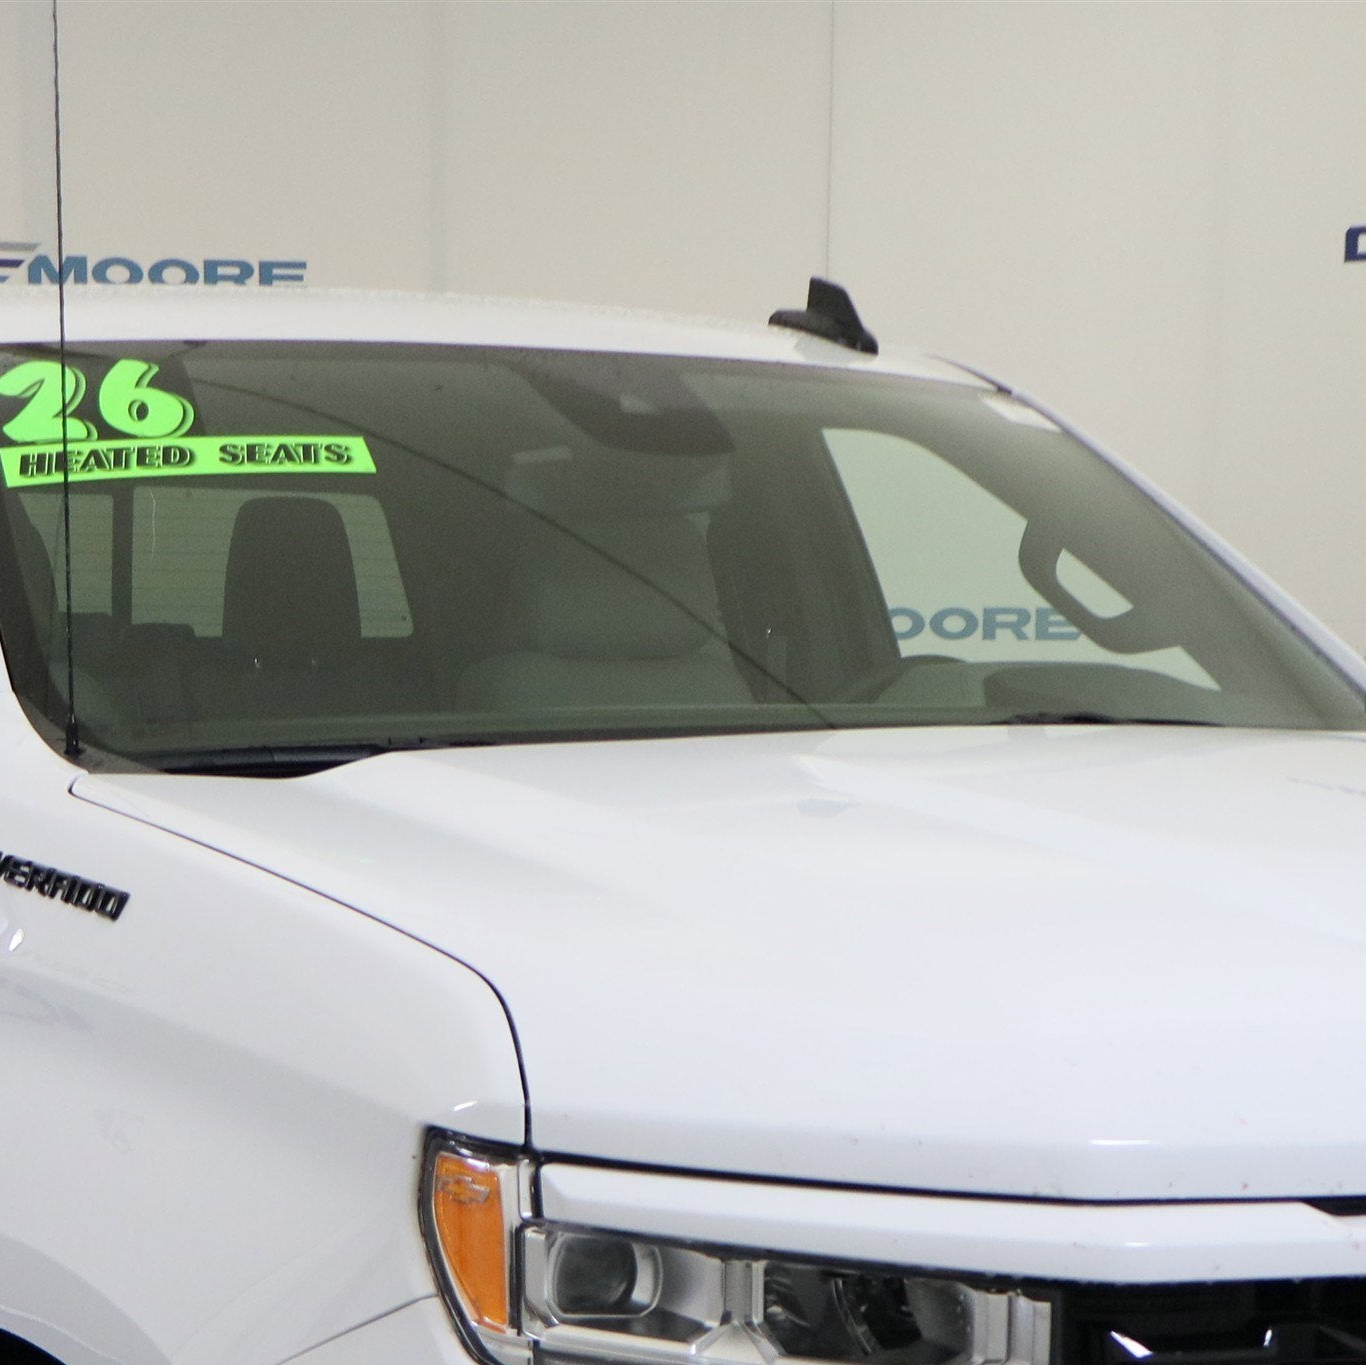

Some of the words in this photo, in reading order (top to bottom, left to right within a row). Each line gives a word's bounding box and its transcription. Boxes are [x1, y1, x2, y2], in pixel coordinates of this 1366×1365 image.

[18, 444, 197, 477] HEATED
[219, 441, 353, 468] SEATS
[888, 607, 1083, 641] OORE
